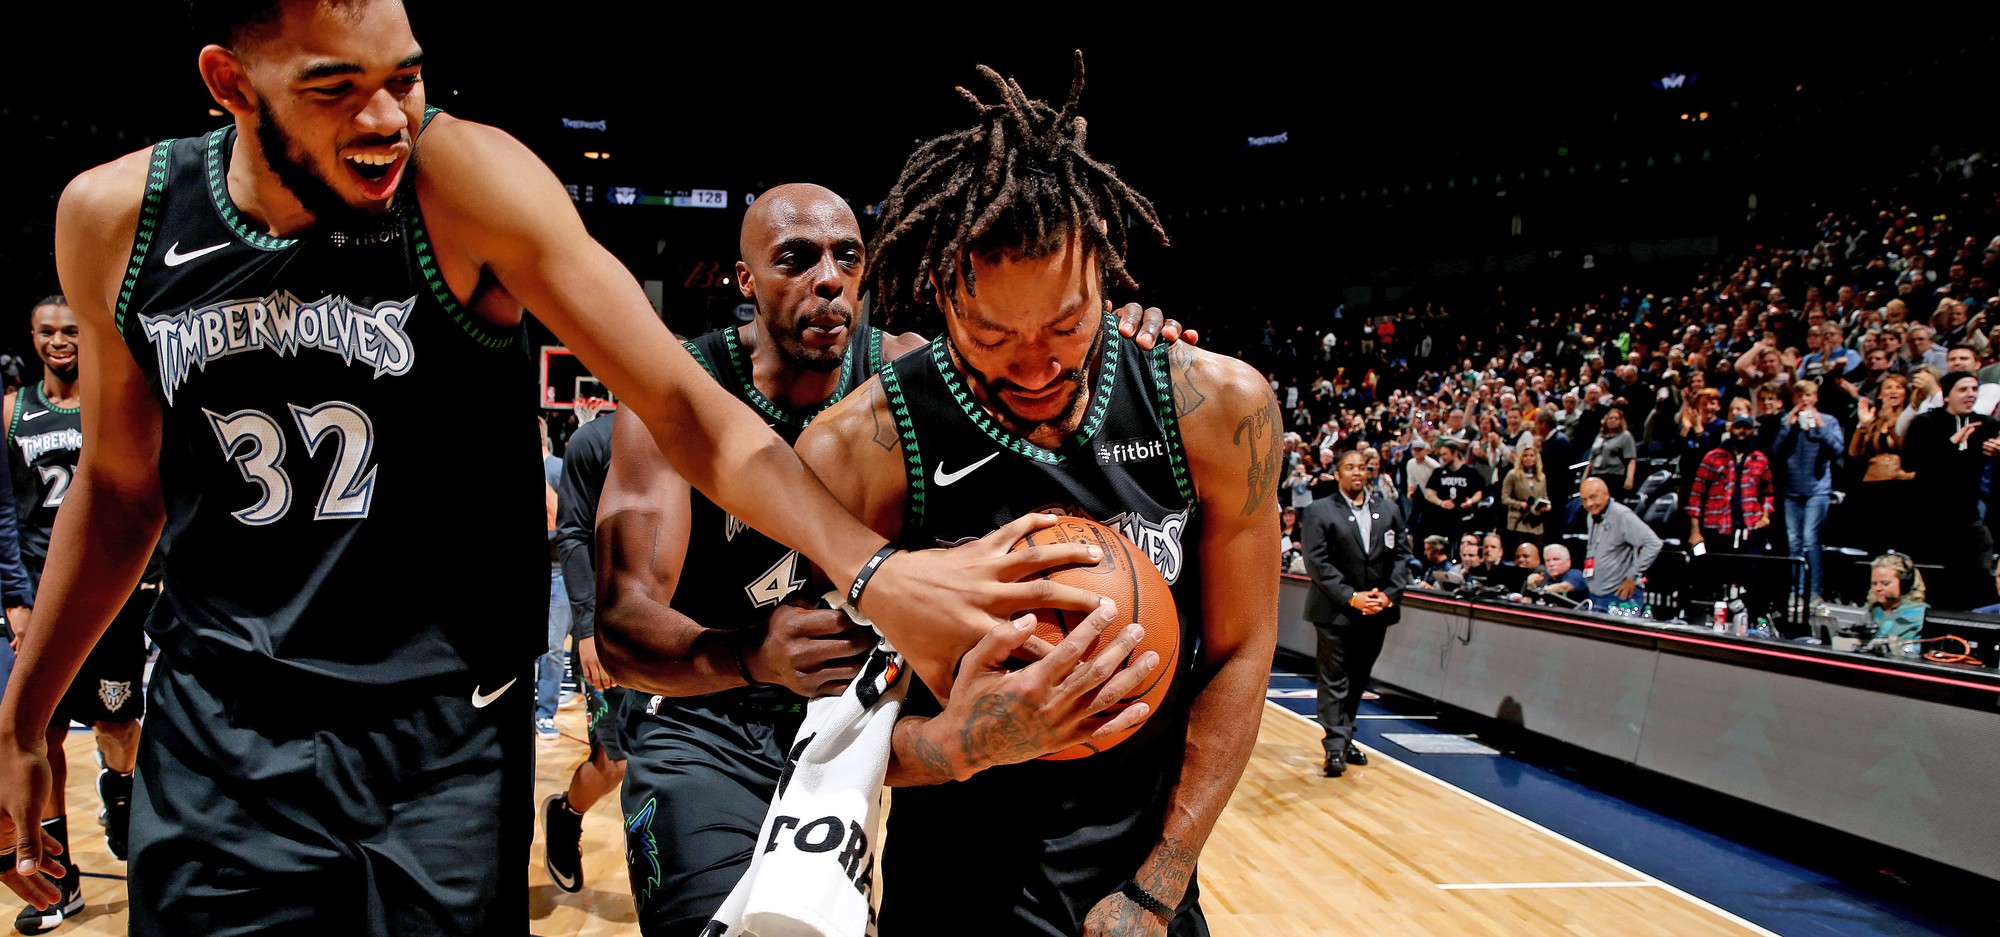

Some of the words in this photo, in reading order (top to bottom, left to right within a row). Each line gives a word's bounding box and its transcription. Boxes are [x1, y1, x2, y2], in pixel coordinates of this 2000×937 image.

[698, 192, 722, 204] 128
[137, 290, 418, 407] TIMBERWOLVES
[201, 401, 378, 526] 32
[1113, 440, 1163, 462] fitbit
[37, 465, 77, 507] 2
[867, 555, 883, 569] WE
[745, 549, 806, 608] 4
[851, 577, 865, 599] FLIP
